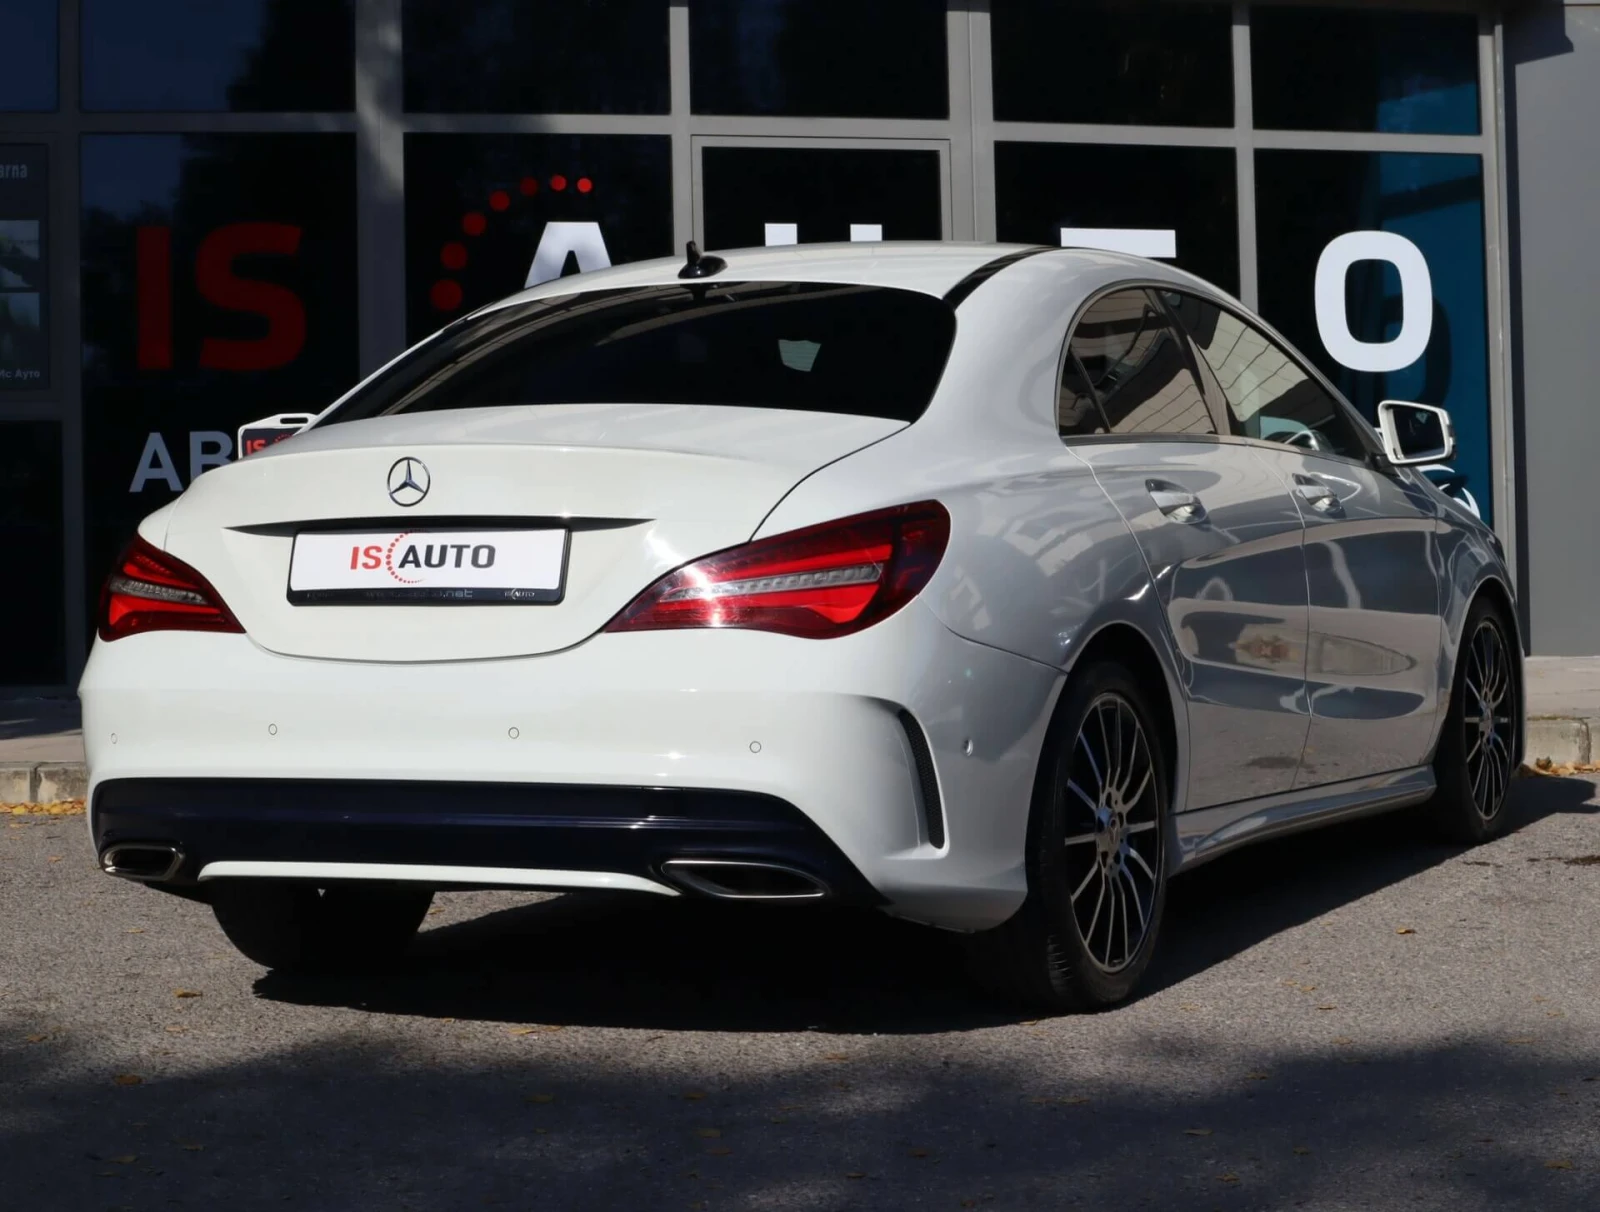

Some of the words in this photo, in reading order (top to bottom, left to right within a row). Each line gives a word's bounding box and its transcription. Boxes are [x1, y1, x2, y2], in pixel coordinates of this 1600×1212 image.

[136, 221, 308, 372] IS
[350, 545, 382, 570] IS
[398, 544, 496, 568] AUTO
